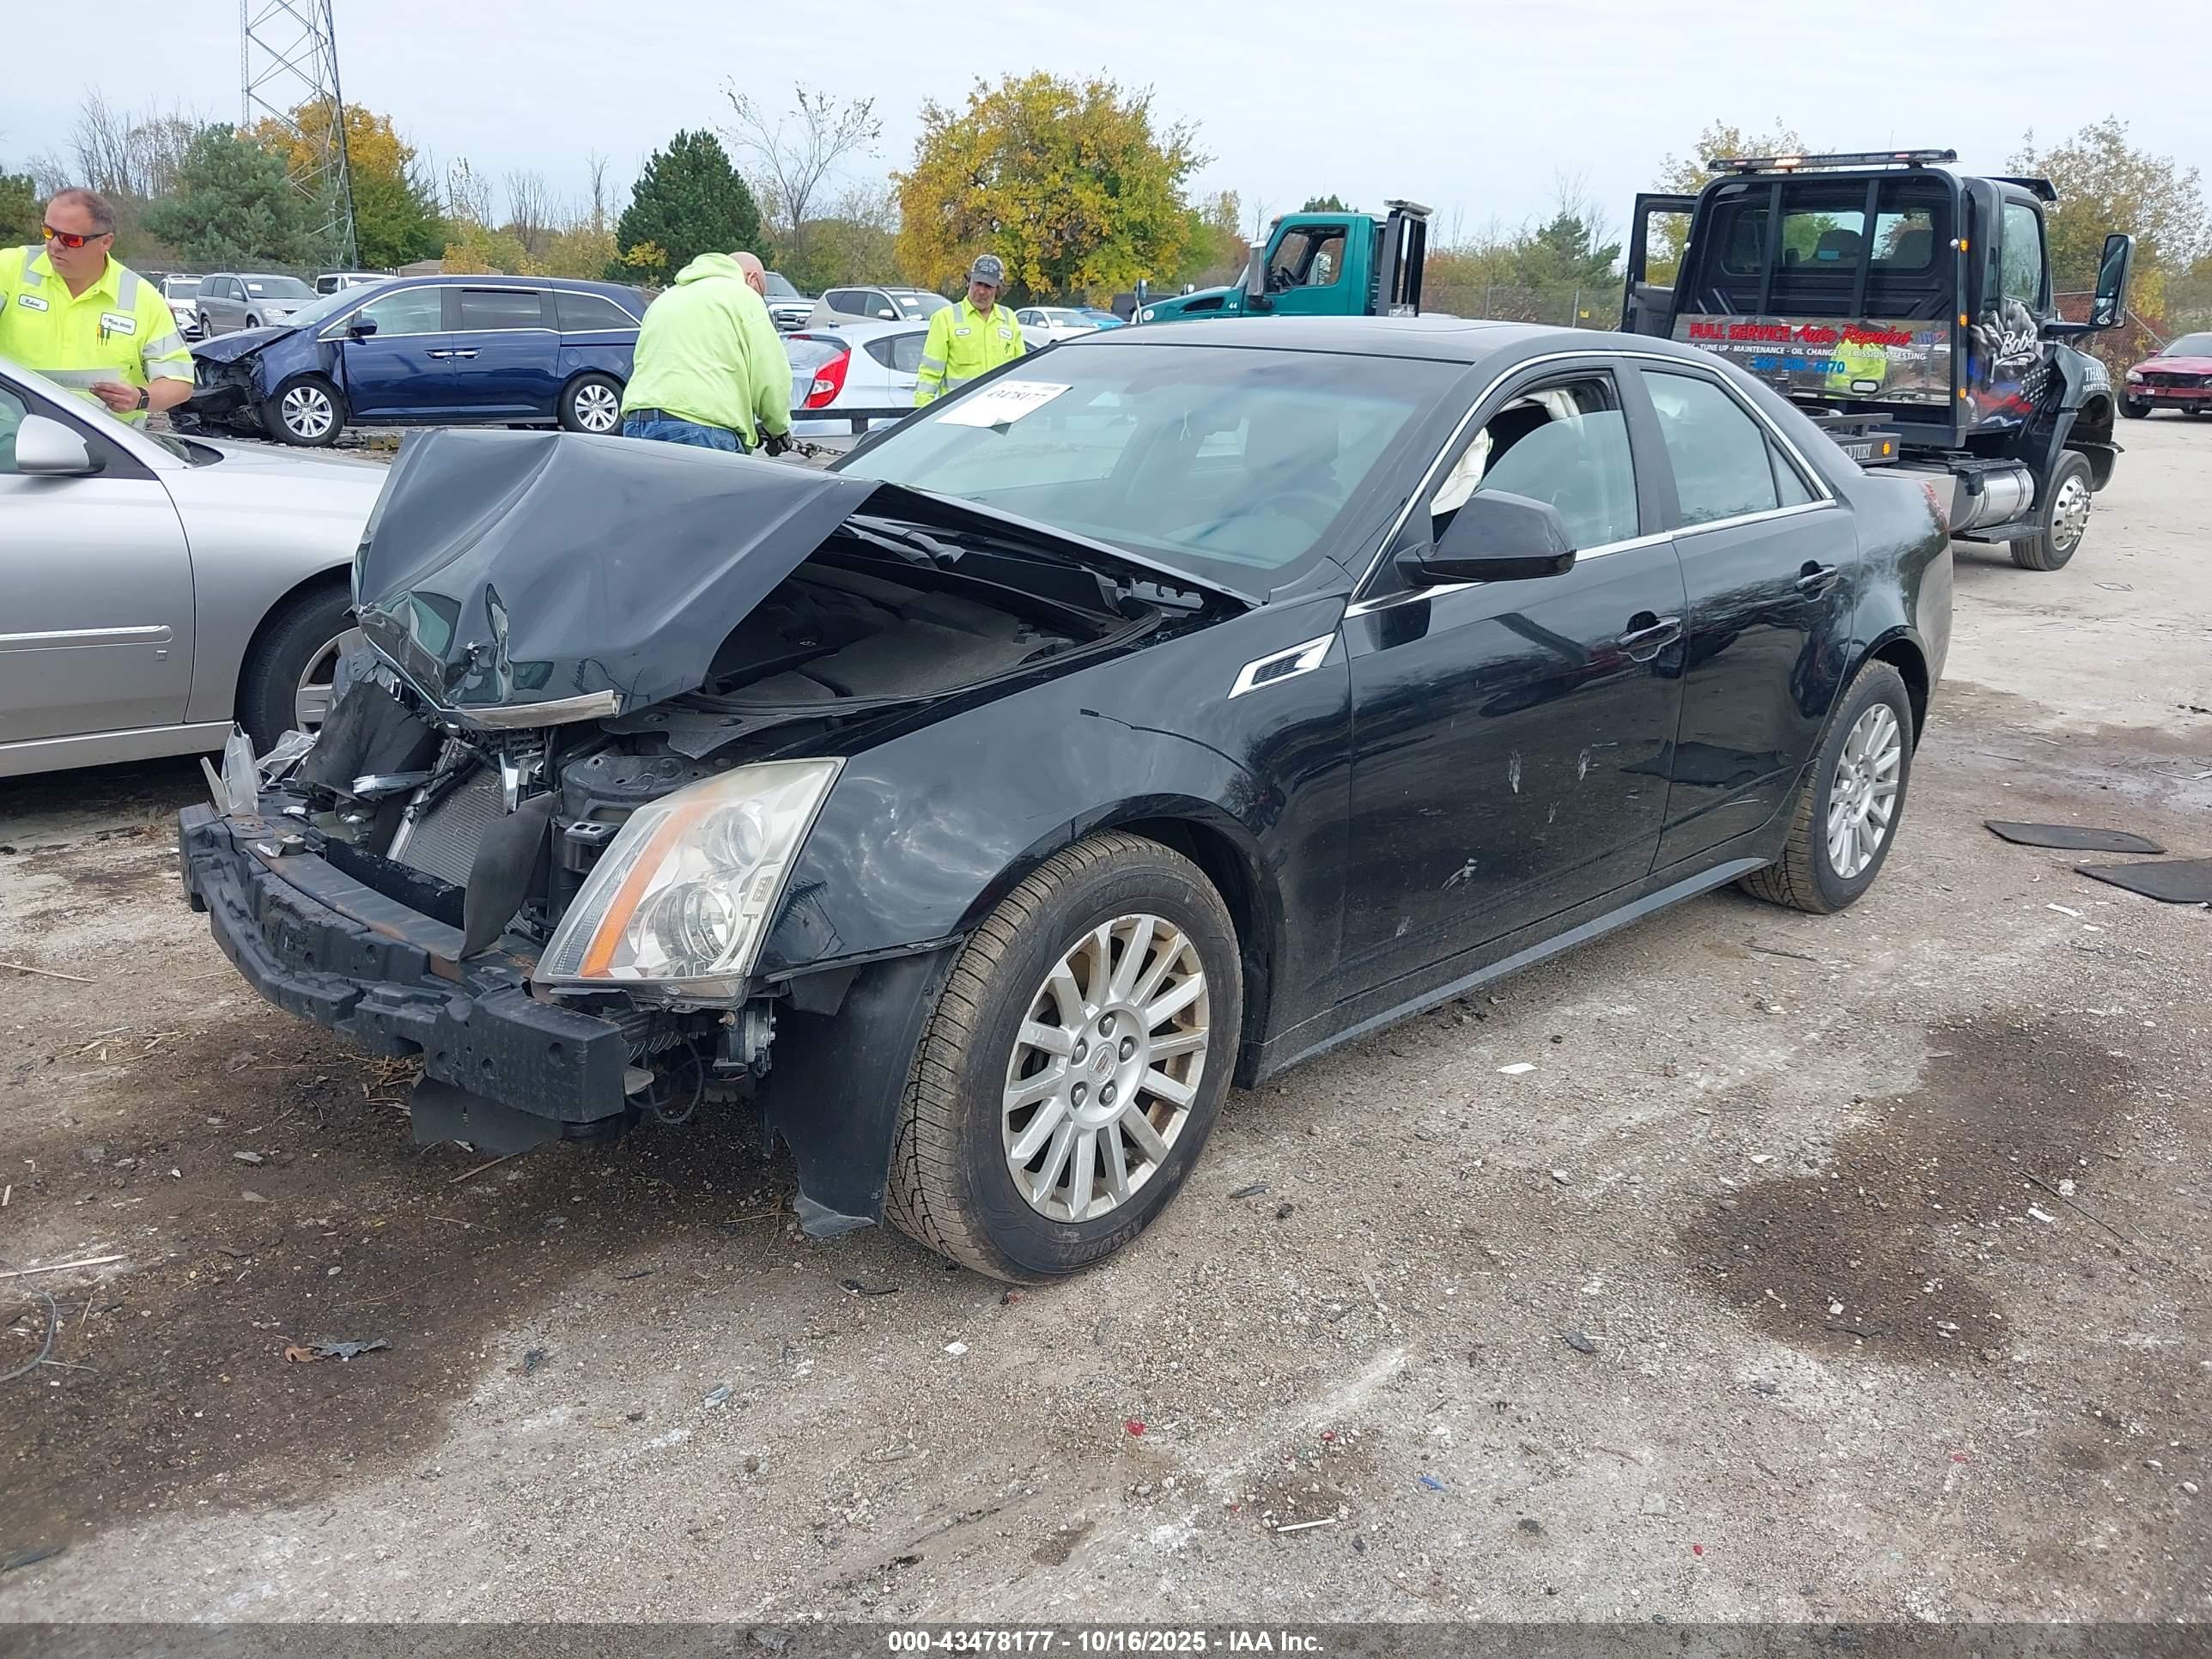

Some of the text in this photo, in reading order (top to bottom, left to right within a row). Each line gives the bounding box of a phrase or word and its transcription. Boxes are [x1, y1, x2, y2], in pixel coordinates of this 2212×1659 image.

[1689, 322, 1725, 339] FULL
[1728, 324, 1792, 342] SERVICE
[1793, 323, 1838, 343] Auto
[1840, 323, 1914, 349] Repairs
[2000, 330, 2035, 358] Bob's
[1733, 344, 1785, 354] MAINTENANCE
[1806, 348, 1842, 356] CHANGES
